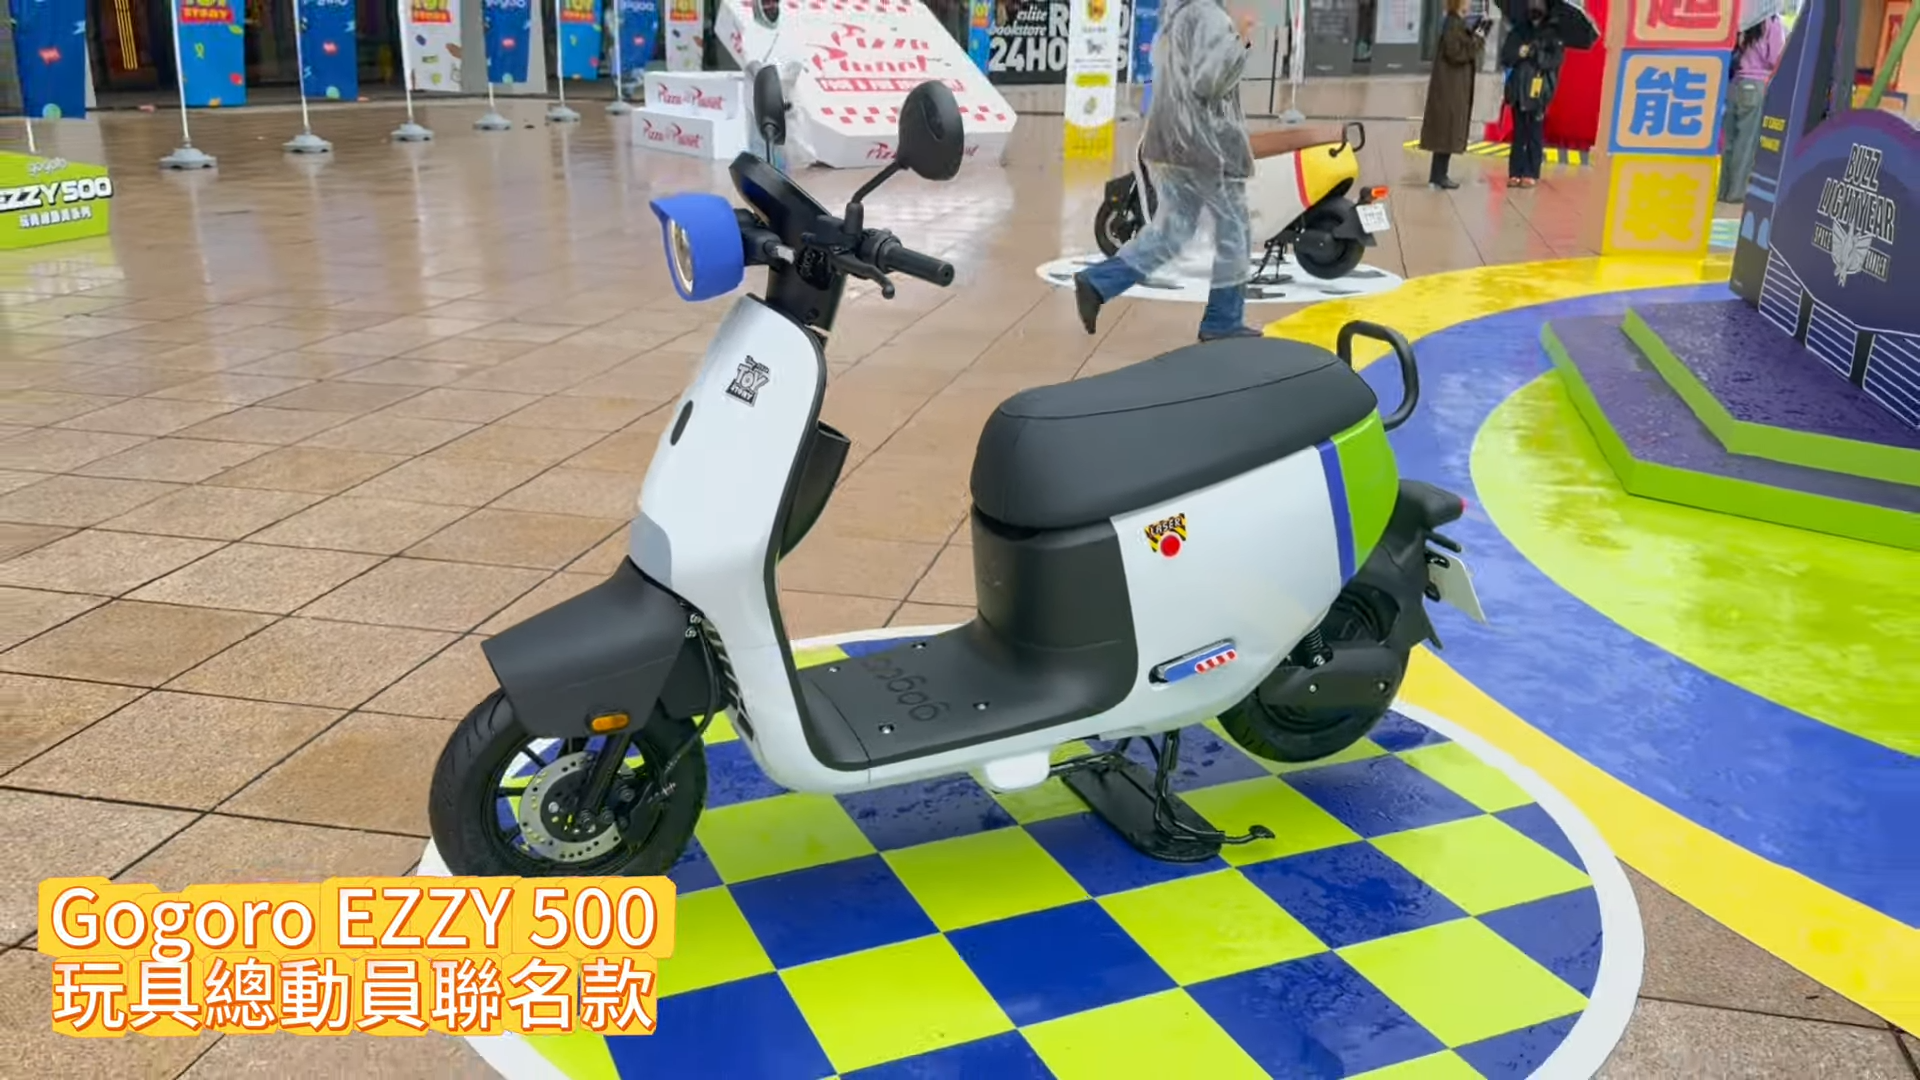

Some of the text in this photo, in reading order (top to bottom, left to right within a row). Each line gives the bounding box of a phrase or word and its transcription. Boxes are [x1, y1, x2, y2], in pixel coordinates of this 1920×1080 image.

[1844, 143, 1882, 192] BUZZ
[1817, 177, 1896, 245] LIGHTYEAR
[735, 363, 770, 392] TOY
[1149, 516, 1182, 538] LASER
